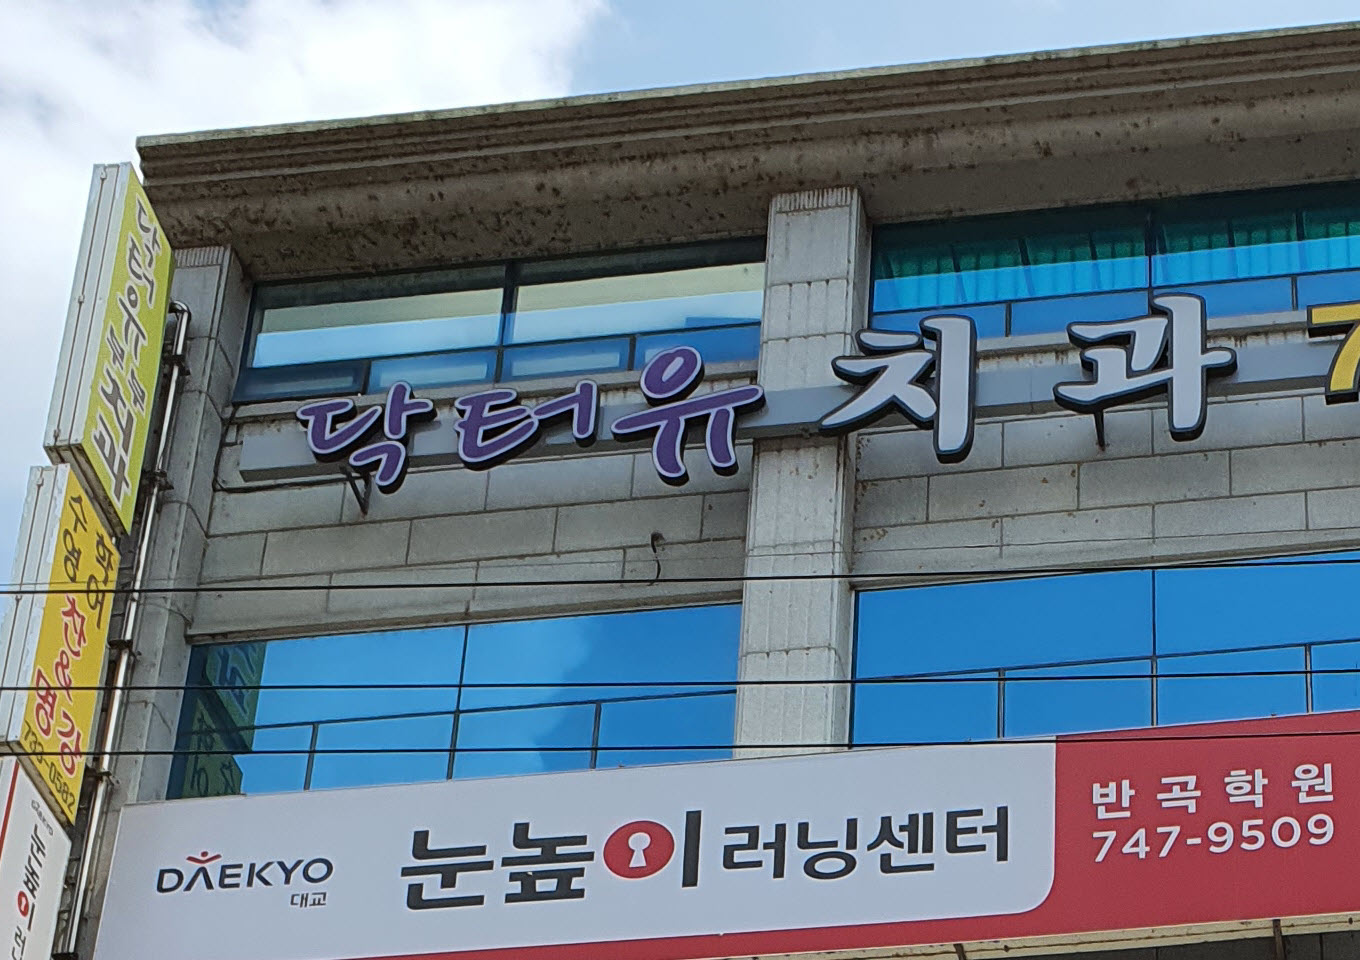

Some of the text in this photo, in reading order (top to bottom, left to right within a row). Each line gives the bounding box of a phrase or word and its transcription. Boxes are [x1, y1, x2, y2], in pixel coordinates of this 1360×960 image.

[92, 193, 162, 508] 닥터유 부부 치과
[297, 346, 766, 493] 닥터유
[819, 294, 1237, 462] 치과
[25, 719, 75, 815] 733-0582
[156, 851, 333, 893] DAEKYO
[401, 806, 1010, 910] 눈높이 러닝센터
[1092, 814, 1335, 862] 747-9509
[290, 892, 327, 908] 대교
